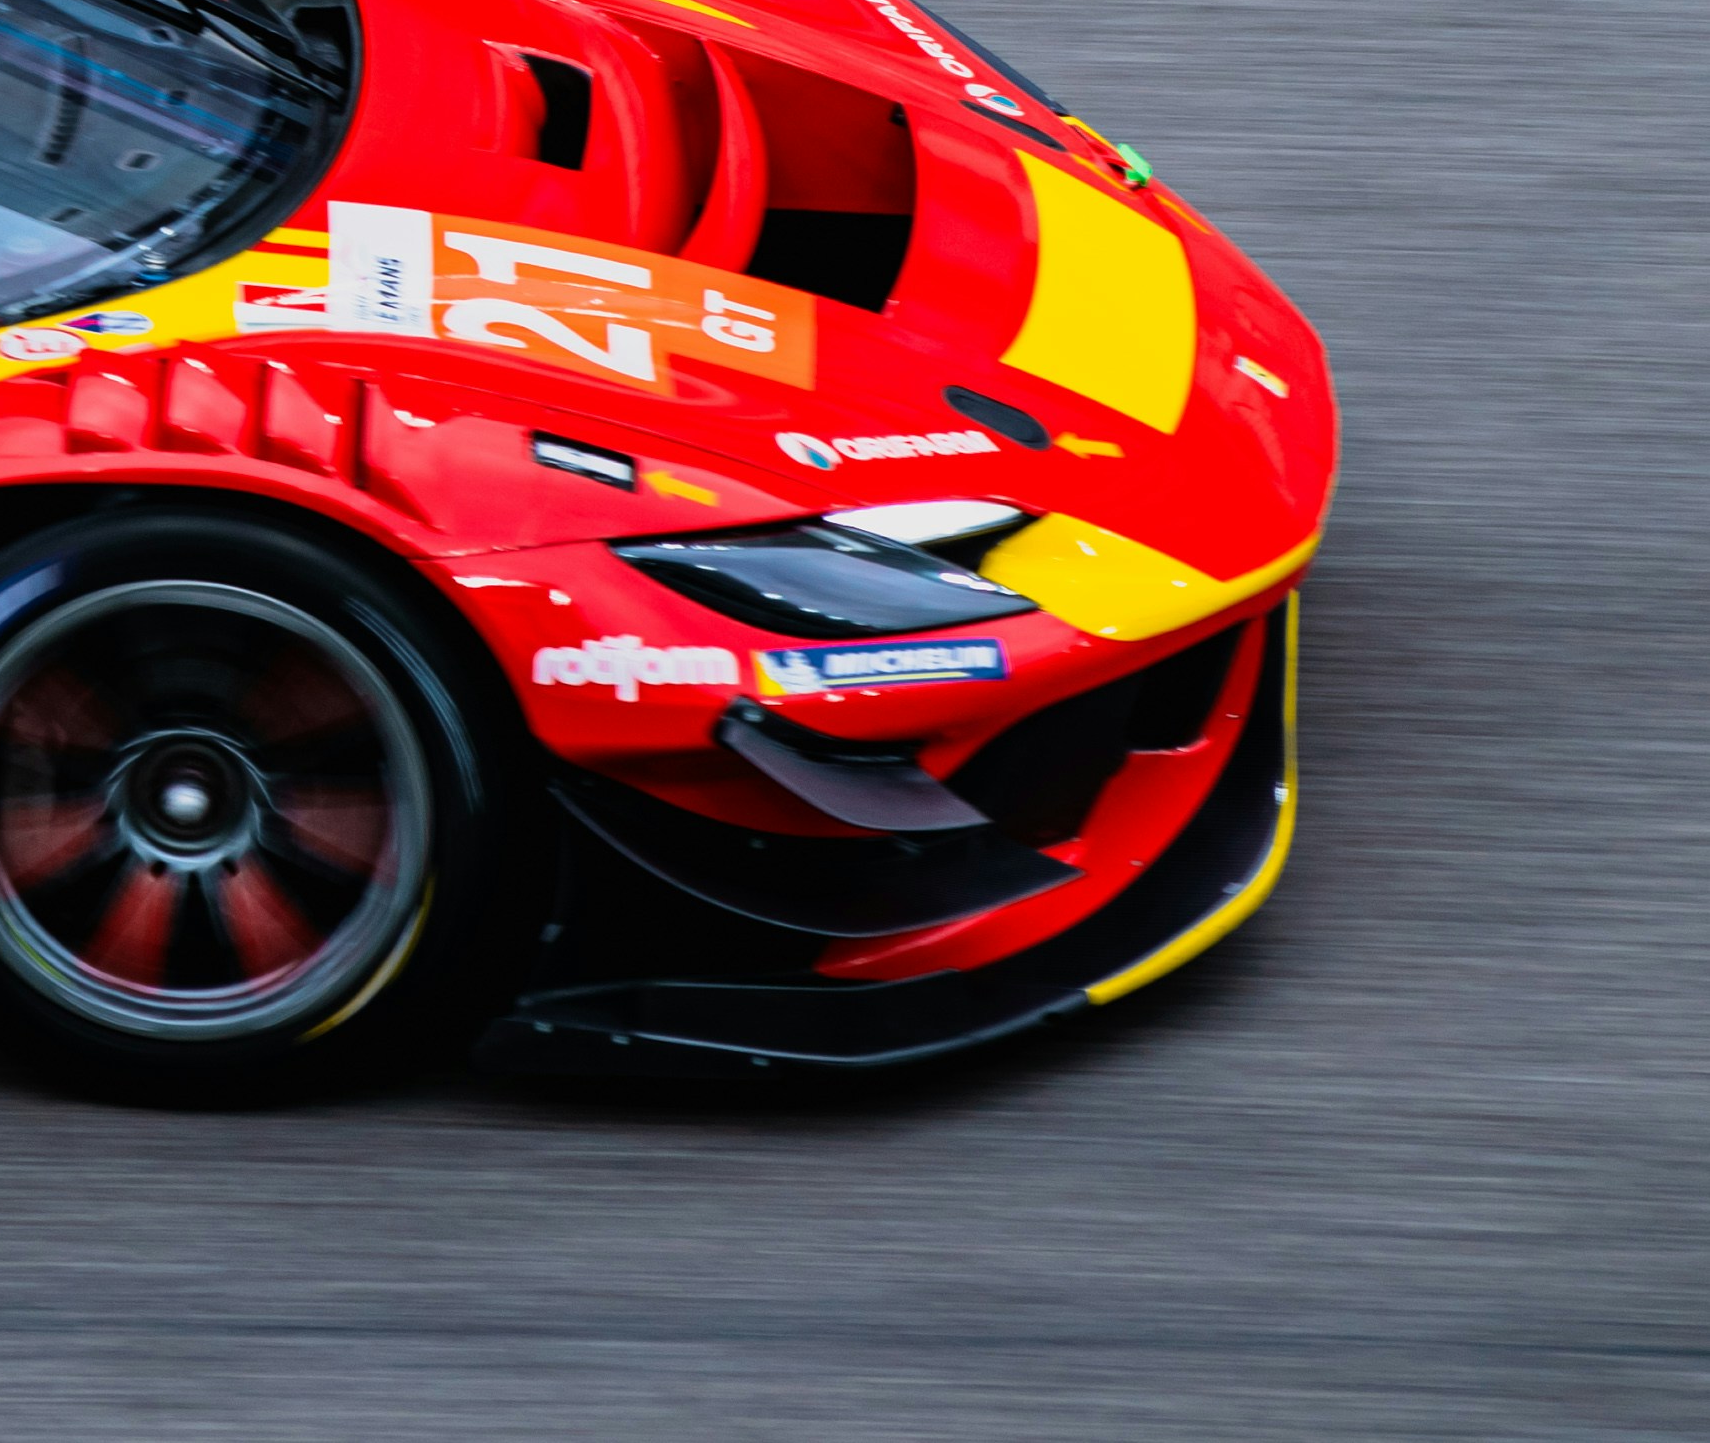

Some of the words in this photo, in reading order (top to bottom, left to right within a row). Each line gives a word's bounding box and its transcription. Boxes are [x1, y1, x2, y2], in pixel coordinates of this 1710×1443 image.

[443, 231, 656, 382] 21
[702, 289, 776, 353] GT
[834, 431, 1000, 461] ORIFARM
[532, 634, 740, 702] rotiform
[824, 646, 998, 676] MICHELIN
